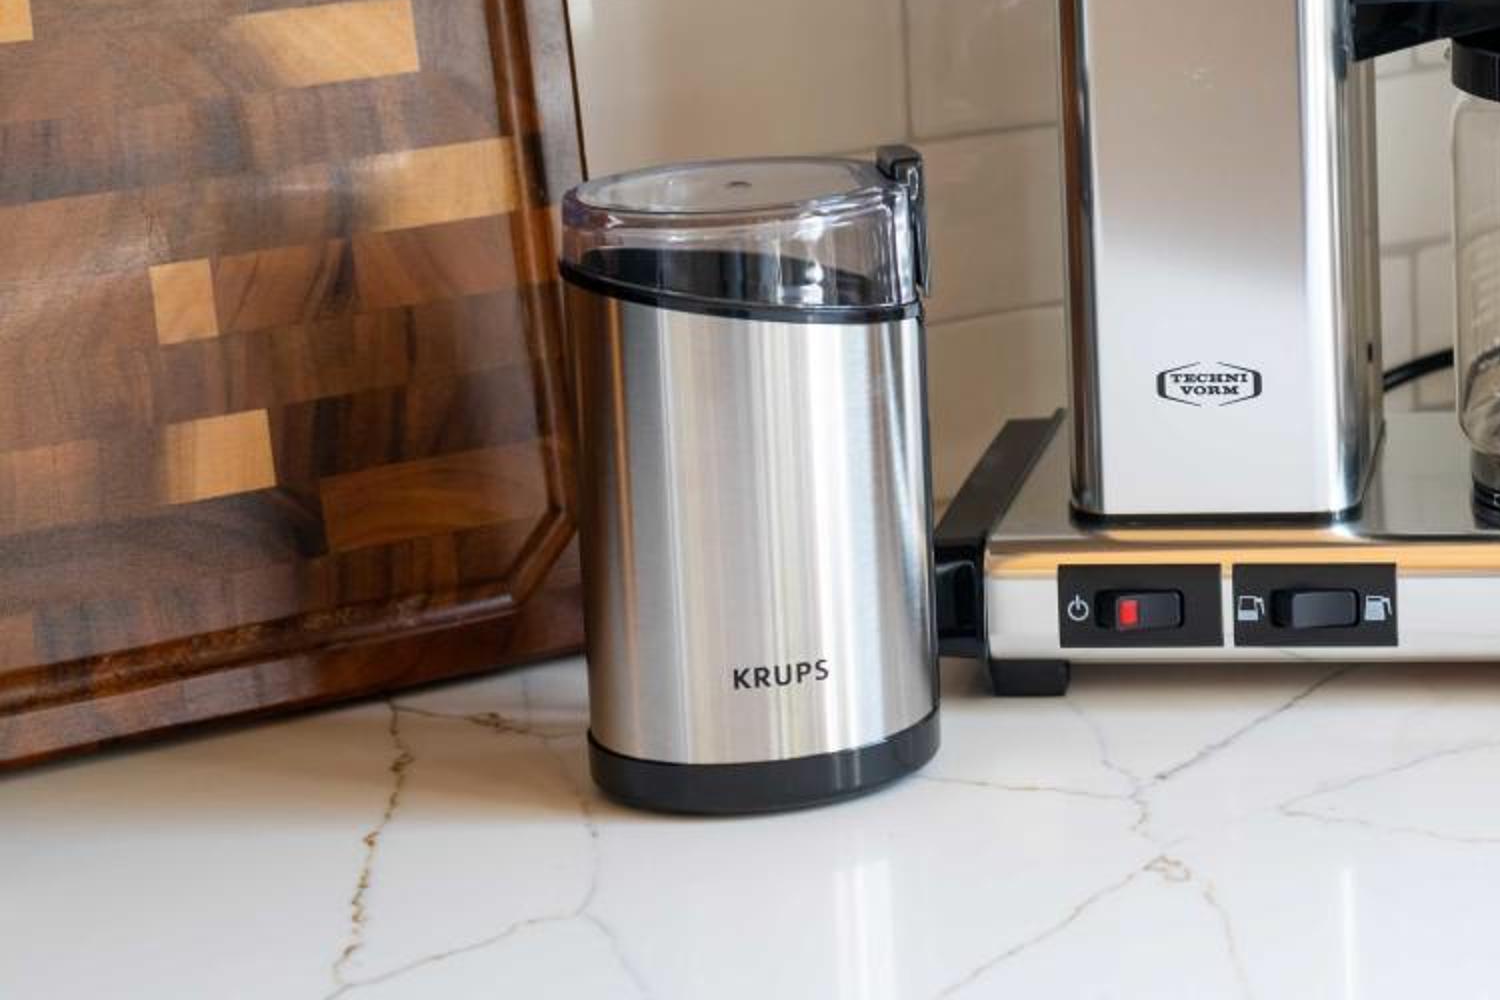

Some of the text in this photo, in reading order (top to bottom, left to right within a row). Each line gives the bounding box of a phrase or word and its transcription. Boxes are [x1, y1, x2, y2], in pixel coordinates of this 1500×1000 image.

[1170, 373, 1248, 383] TECHNI
[1180, 386, 1239, 395] VORM
[733, 659, 829, 690] KRUPS
